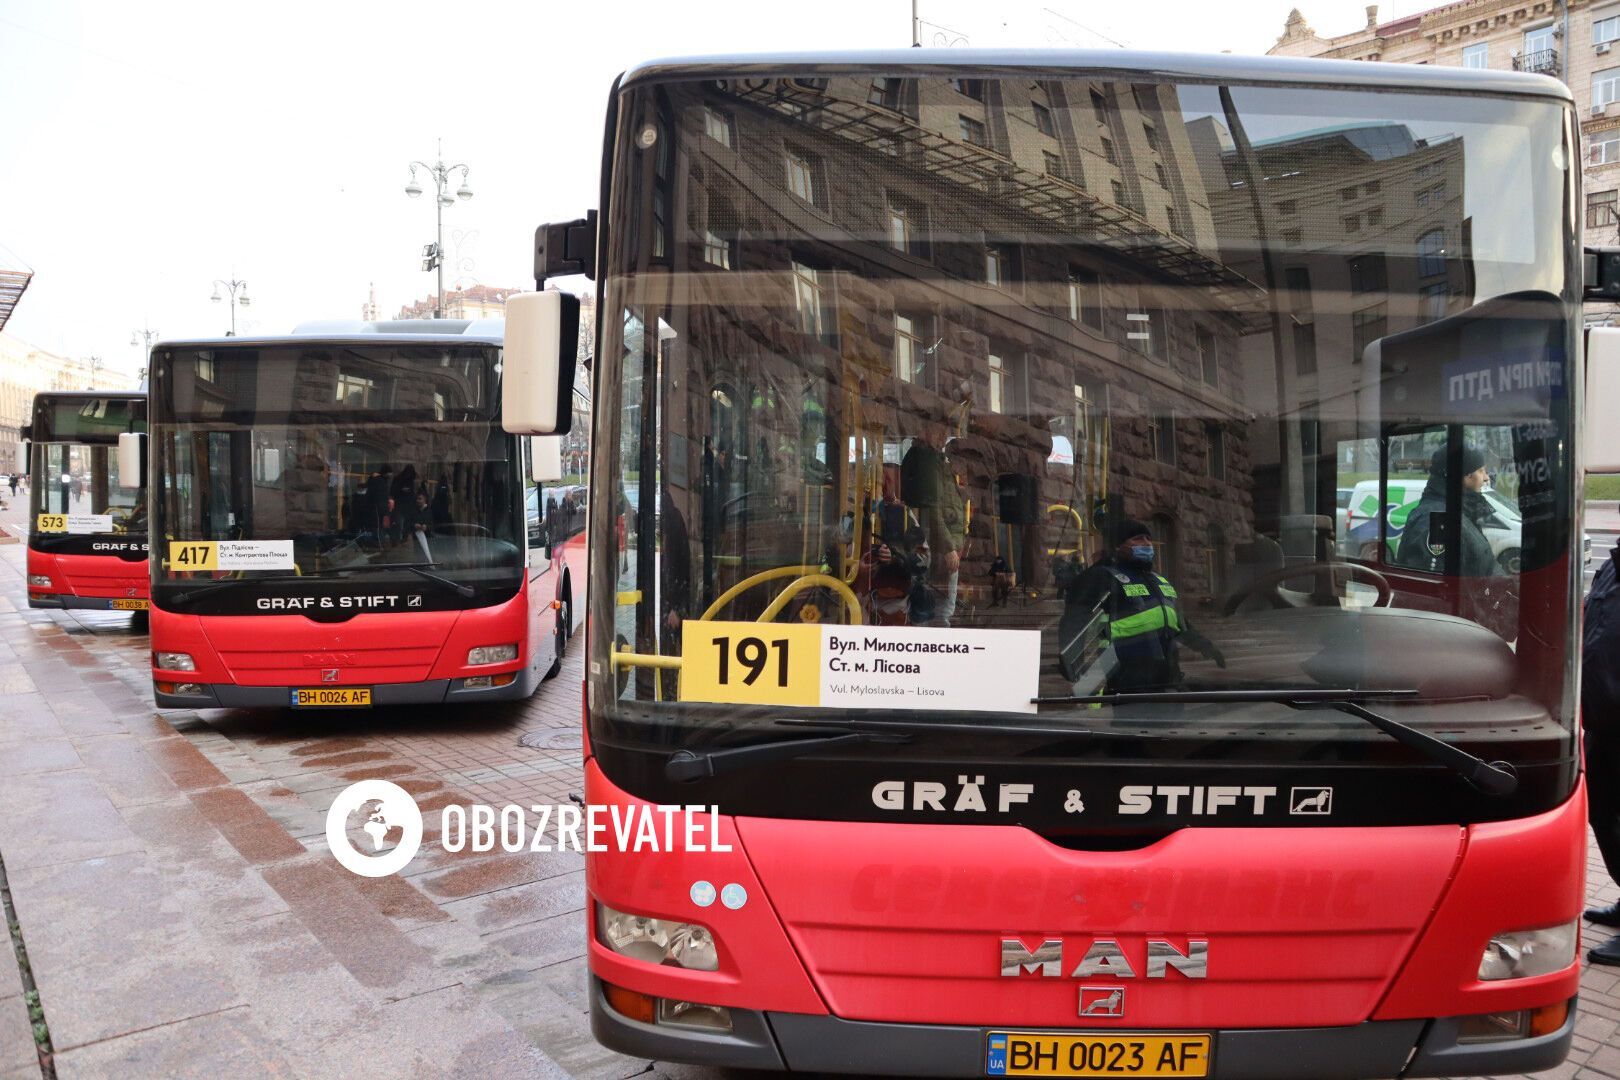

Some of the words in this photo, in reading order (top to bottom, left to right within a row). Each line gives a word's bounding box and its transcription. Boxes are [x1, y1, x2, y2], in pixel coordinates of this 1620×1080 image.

[42, 516, 63, 528] 573
[177, 546, 210, 565] 417
[256, 597, 315, 610] GRÄF
[319, 597, 334, 609] &
[339, 595, 399, 607] STIFT
[829, 636, 861, 653] Вул.
[863, 638, 970, 654] Милославська
[712, 636, 790, 688] 191
[829, 658, 851, 673] Ст.
[854, 662, 869, 673] м.
[872, 659, 921, 675] Лісова
[298, 691, 317, 704] BH
[320, 691, 348, 704] 0026
[351, 691, 369, 704] AF
[830, 684, 848, 695] Vul.
[850, 685, 905, 697] Myloslavska
[917, 687, 945, 697] Lisova
[871, 775, 1034, 812] GRÄF
[1063, 789, 1085, 814] &
[1118, 786, 1277, 815] STIFT
[1000, 938, 1209, 979] MAN
[989, 1059, 1005, 1070] UA
[1010, 1042, 1057, 1071] BH
[1069, 1042, 1144, 1071] 0023
[1156, 1042, 1204, 1071] AF
